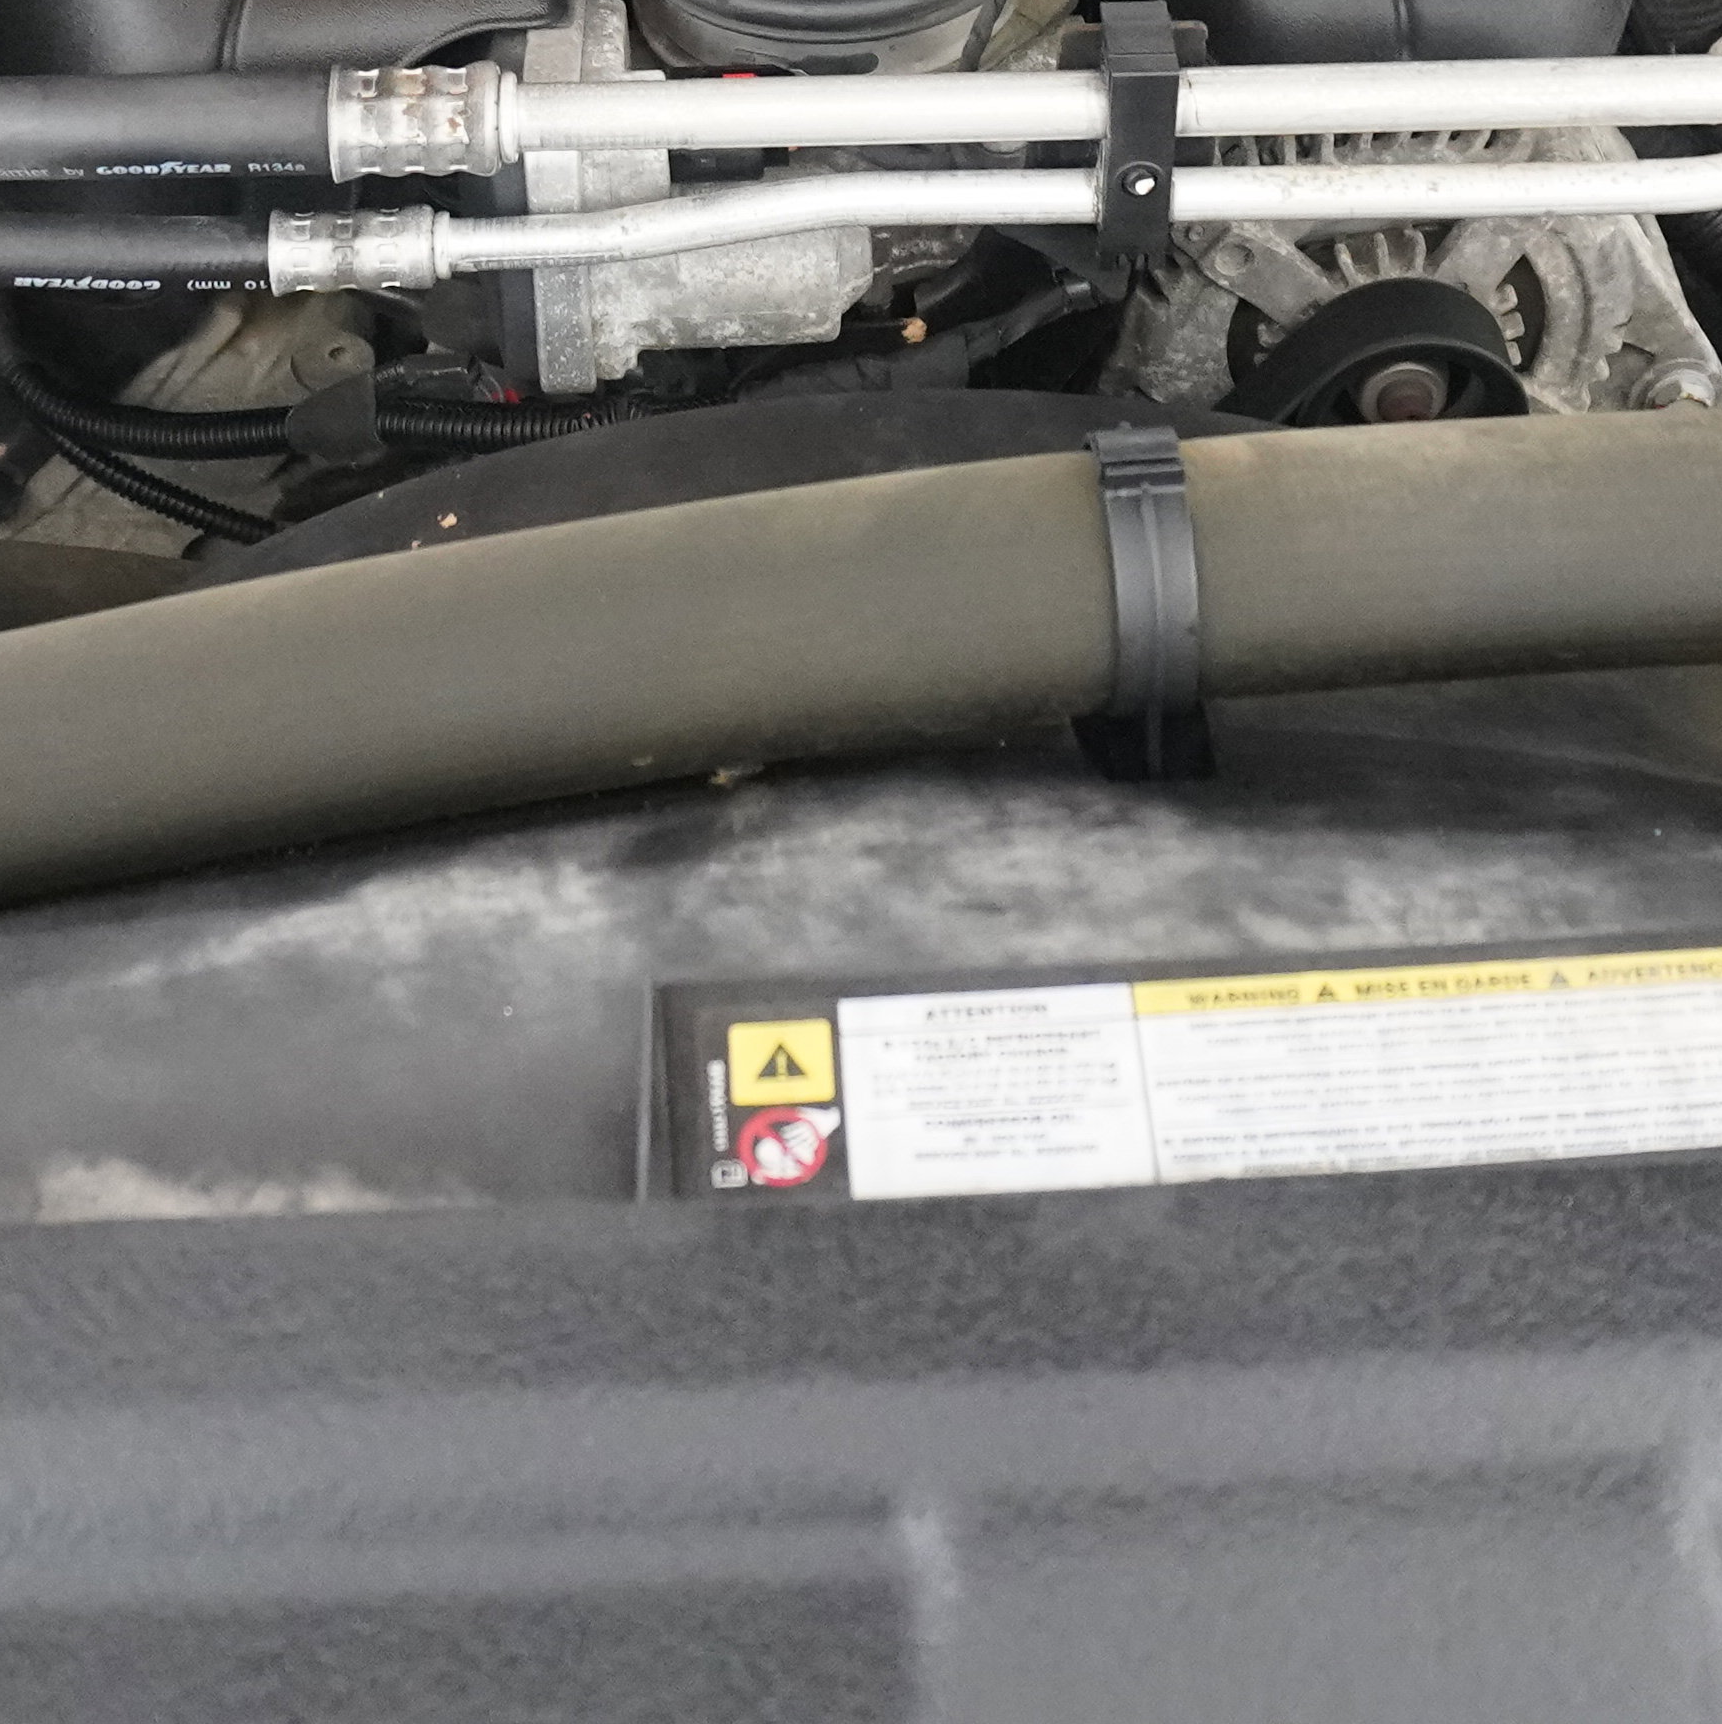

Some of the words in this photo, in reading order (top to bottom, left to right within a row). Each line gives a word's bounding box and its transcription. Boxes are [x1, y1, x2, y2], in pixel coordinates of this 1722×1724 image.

[96, 160, 231, 176] GOODYEAR
[248, 162, 305, 173] R134a
[13, 275, 161, 291] GOODYEAR
[186, 279, 231, 291] mm)
